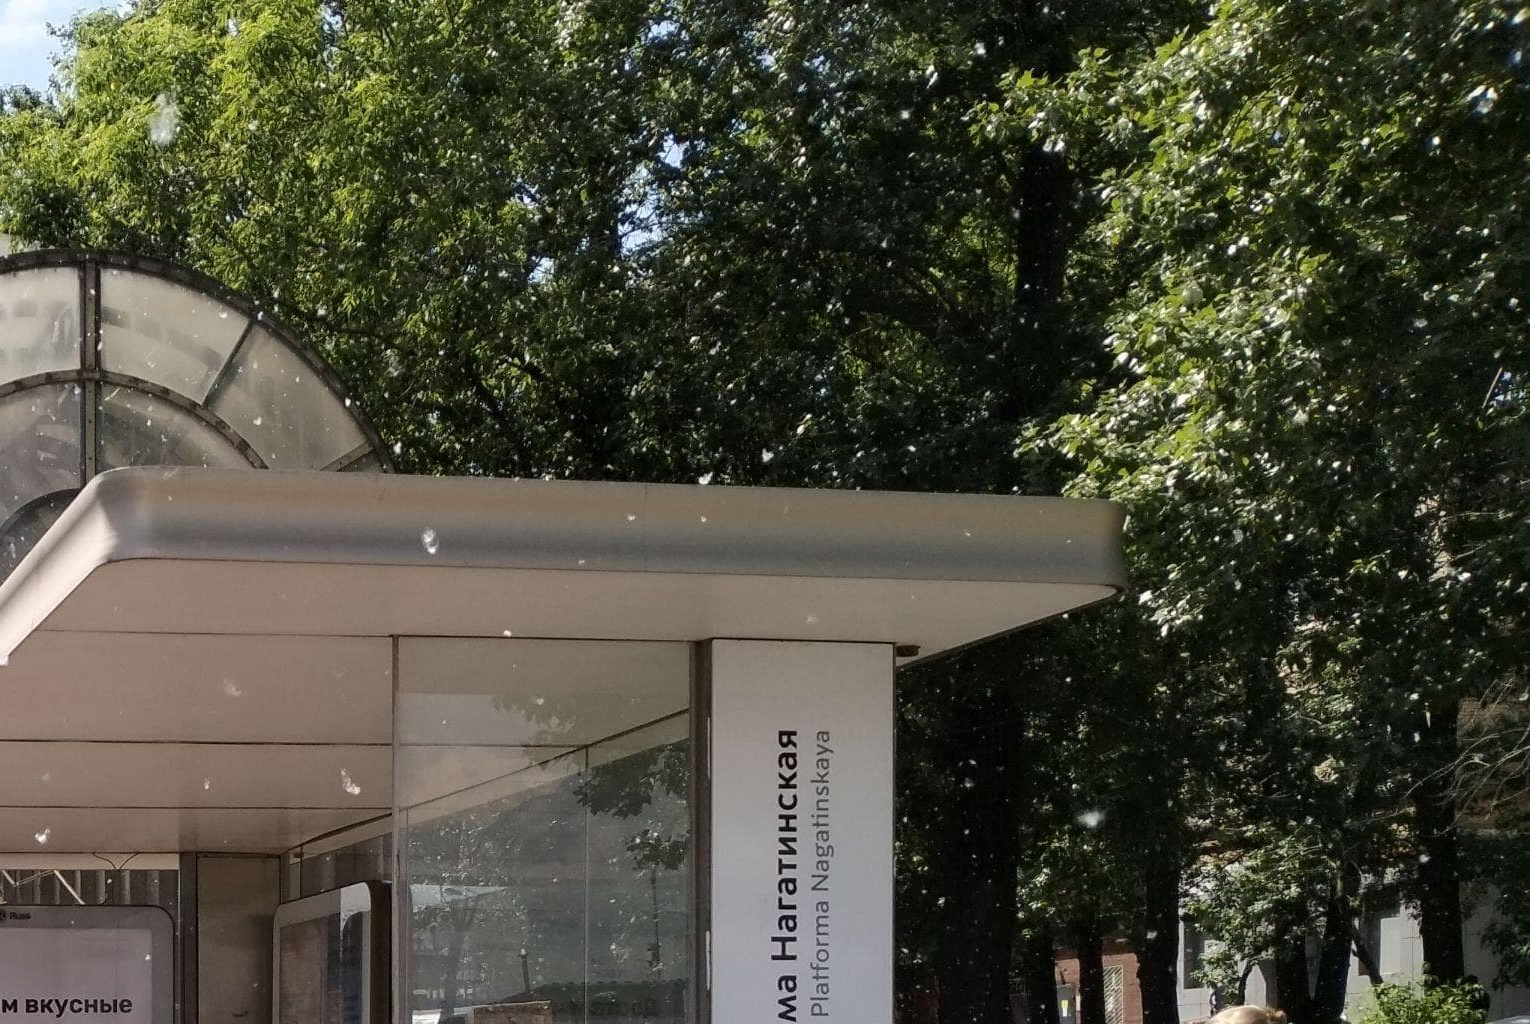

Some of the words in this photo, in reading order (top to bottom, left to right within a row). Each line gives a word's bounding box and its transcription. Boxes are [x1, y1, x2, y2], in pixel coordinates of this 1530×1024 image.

[771, 730, 797, 960] Нагатинская
[810, 731, 834, 891] Nagatinskaya
[25, 998, 133, 1018] вкусные
[810, 901, 829, 1017] Platforma
